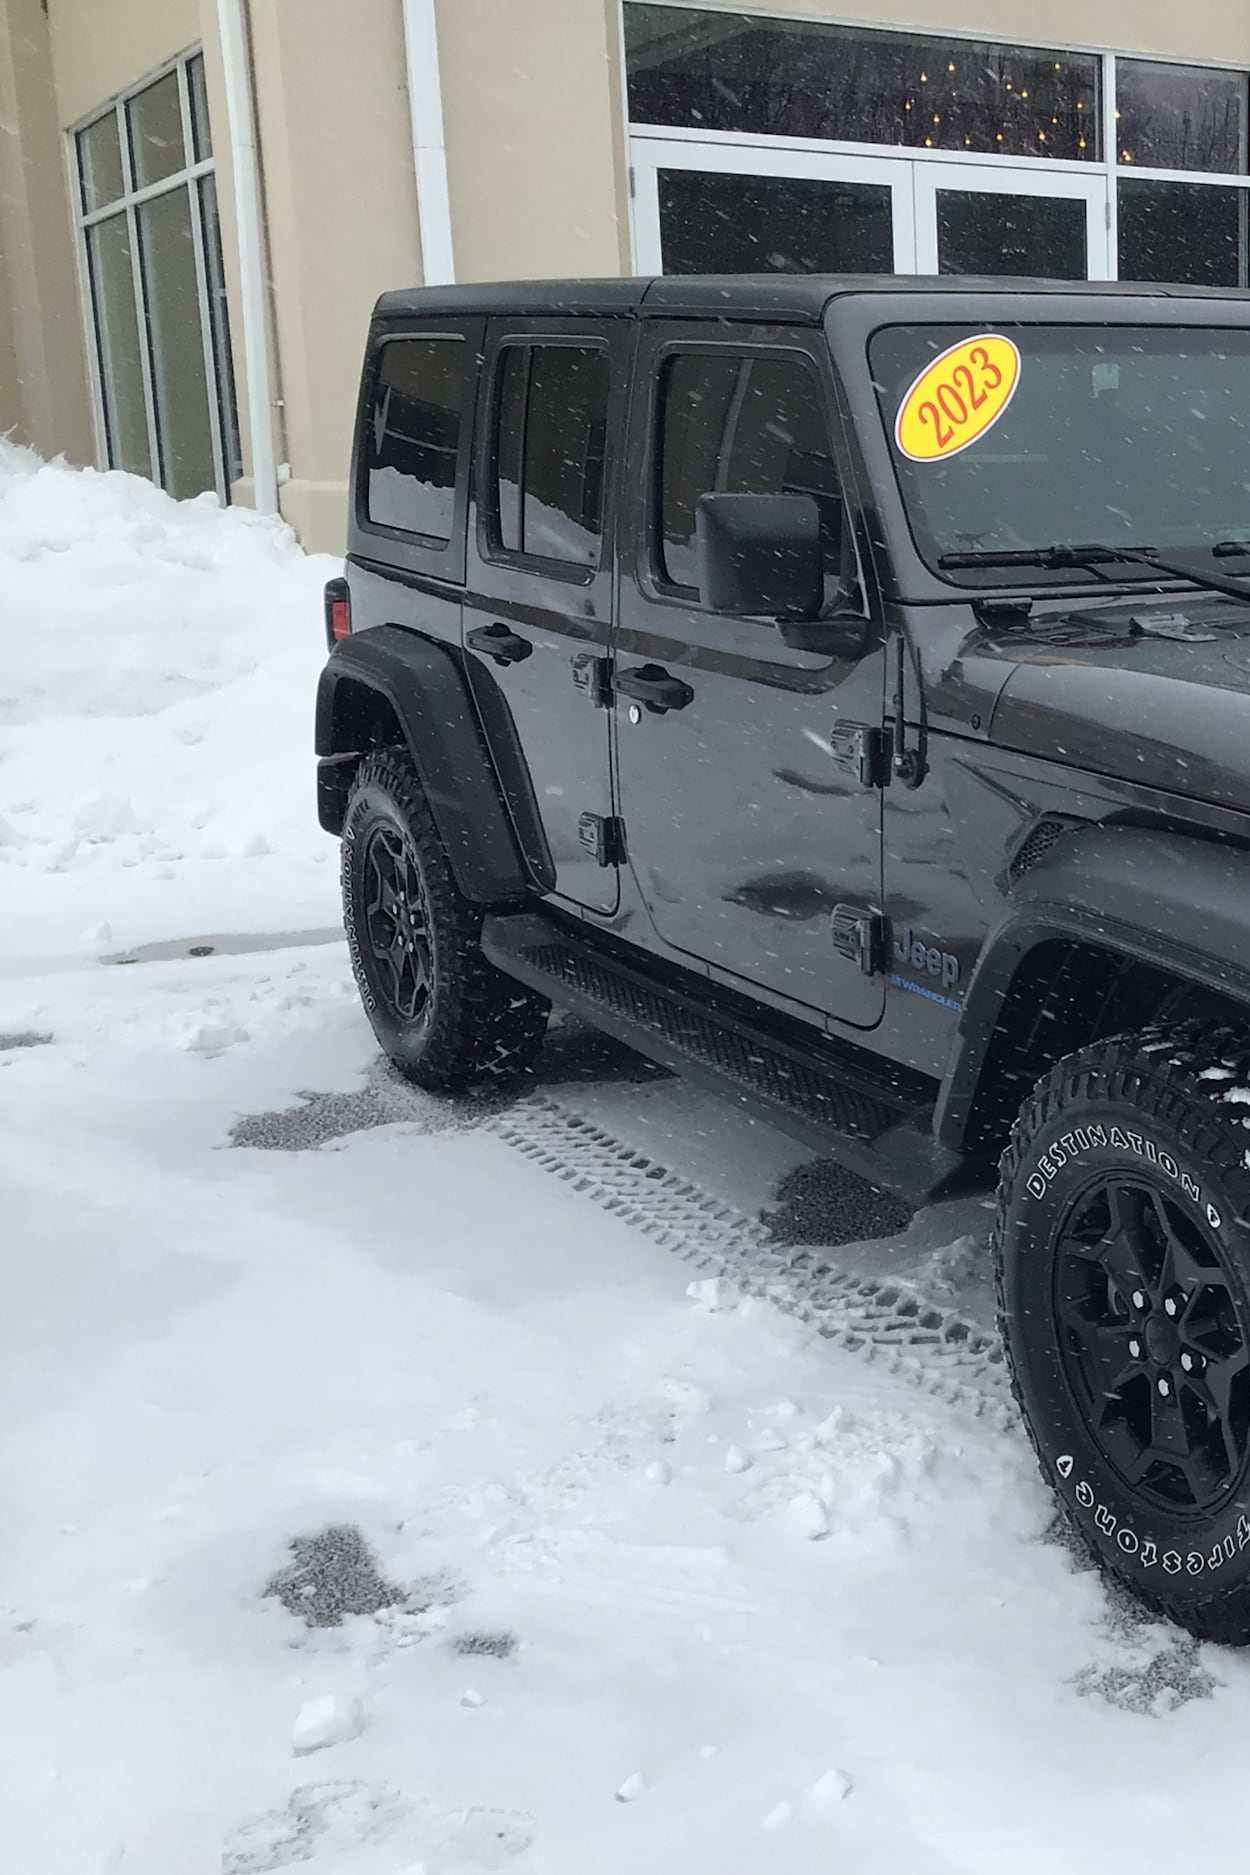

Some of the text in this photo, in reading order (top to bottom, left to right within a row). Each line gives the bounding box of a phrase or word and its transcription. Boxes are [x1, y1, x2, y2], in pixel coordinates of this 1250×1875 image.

[918, 347, 1002, 448] 2023
[893, 928, 960, 988] Jeep
[1026, 1124, 1200, 1201] DESTINATION
